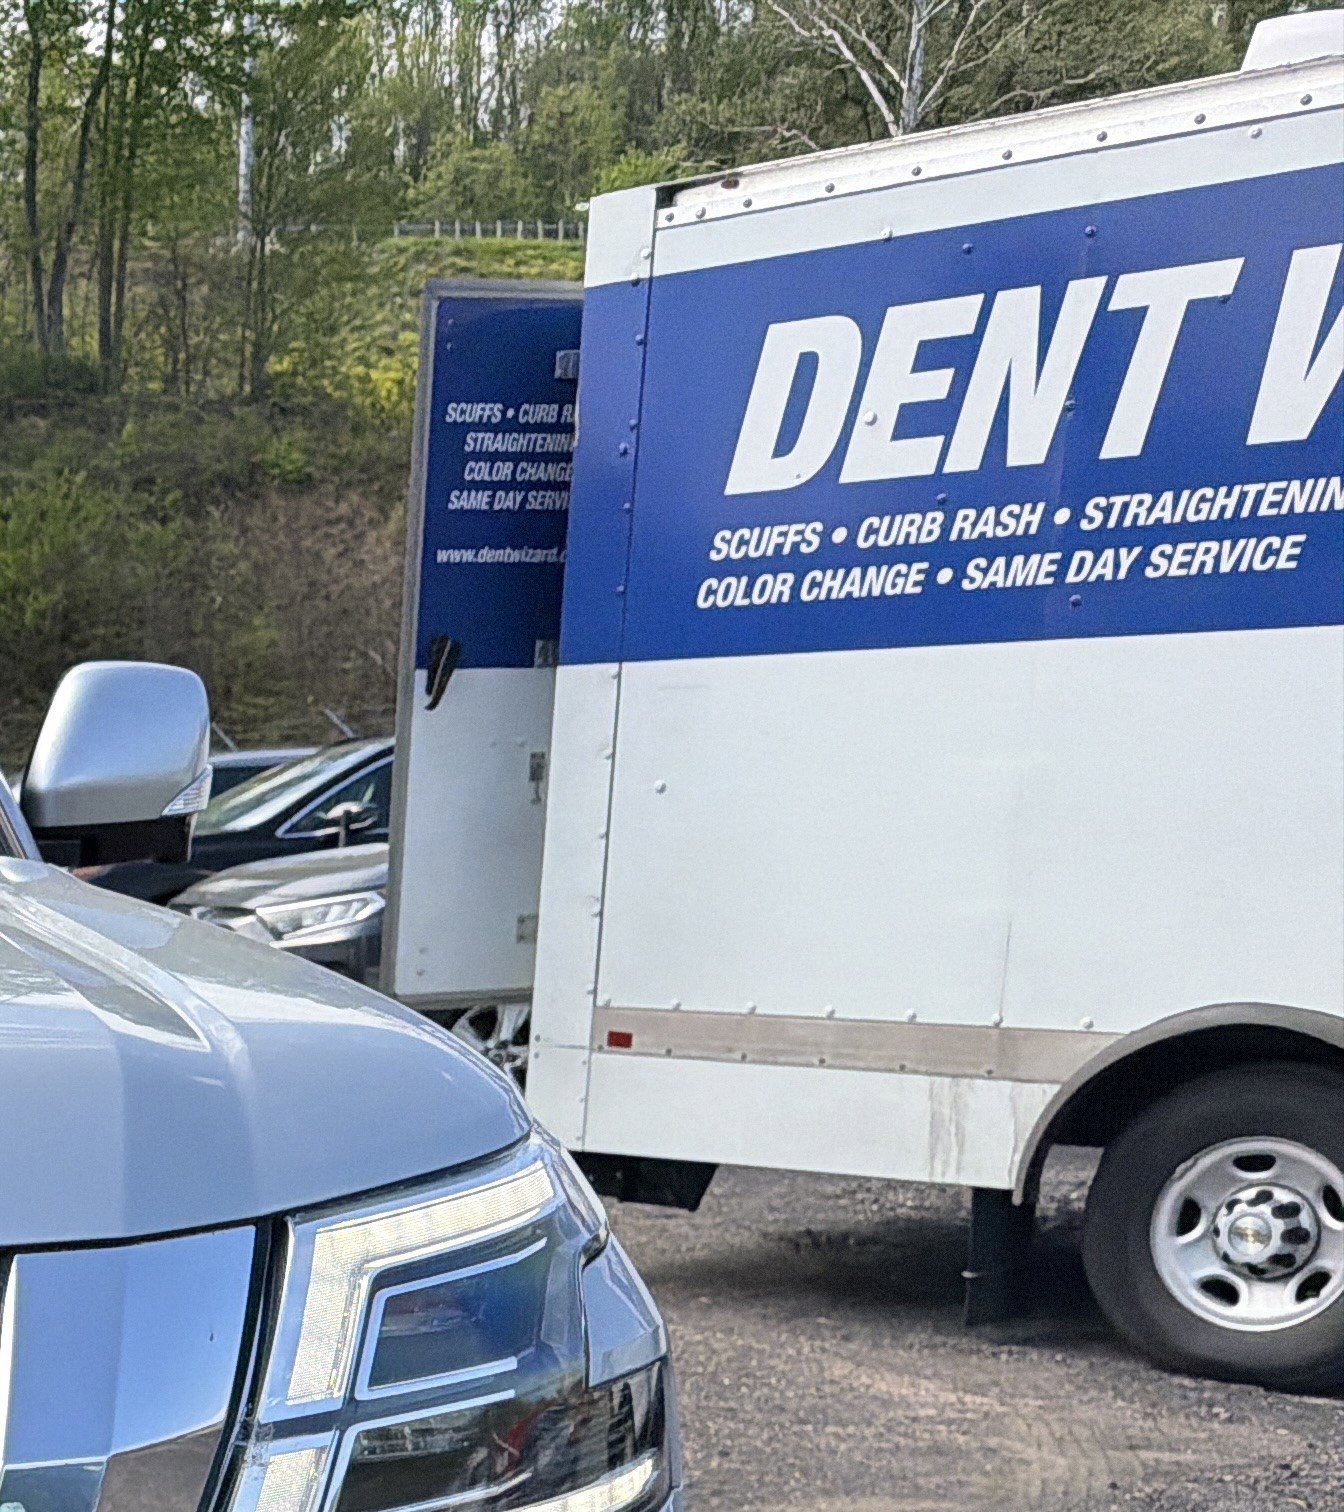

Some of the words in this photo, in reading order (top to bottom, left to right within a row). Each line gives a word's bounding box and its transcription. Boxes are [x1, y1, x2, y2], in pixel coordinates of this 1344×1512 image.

[723, 256, 1246, 497] DENT
[444, 402, 504, 424] SCUFFS
[518, 403, 559, 424] CURB
[561, 404, 575, 423] R
[464, 432, 574, 453] STRAIGHTENIN
[464, 461, 513, 481] COLOR
[515, 461, 572, 482] CHANGE
[448, 490, 492, 510] SAME
[493, 490, 526, 511] DAY
[709, 521, 824, 561] SCUFFS
[856, 510, 945, 549] CURB
[949, 502, 1046, 541] RASH
[696, 572, 795, 609] COLOR
[800, 561, 930, 602] CHANGE
[961, 551, 1063, 591] SAME
[1064, 545, 1144, 584] DAY
[1144, 534, 1307, 579] SERVICE
